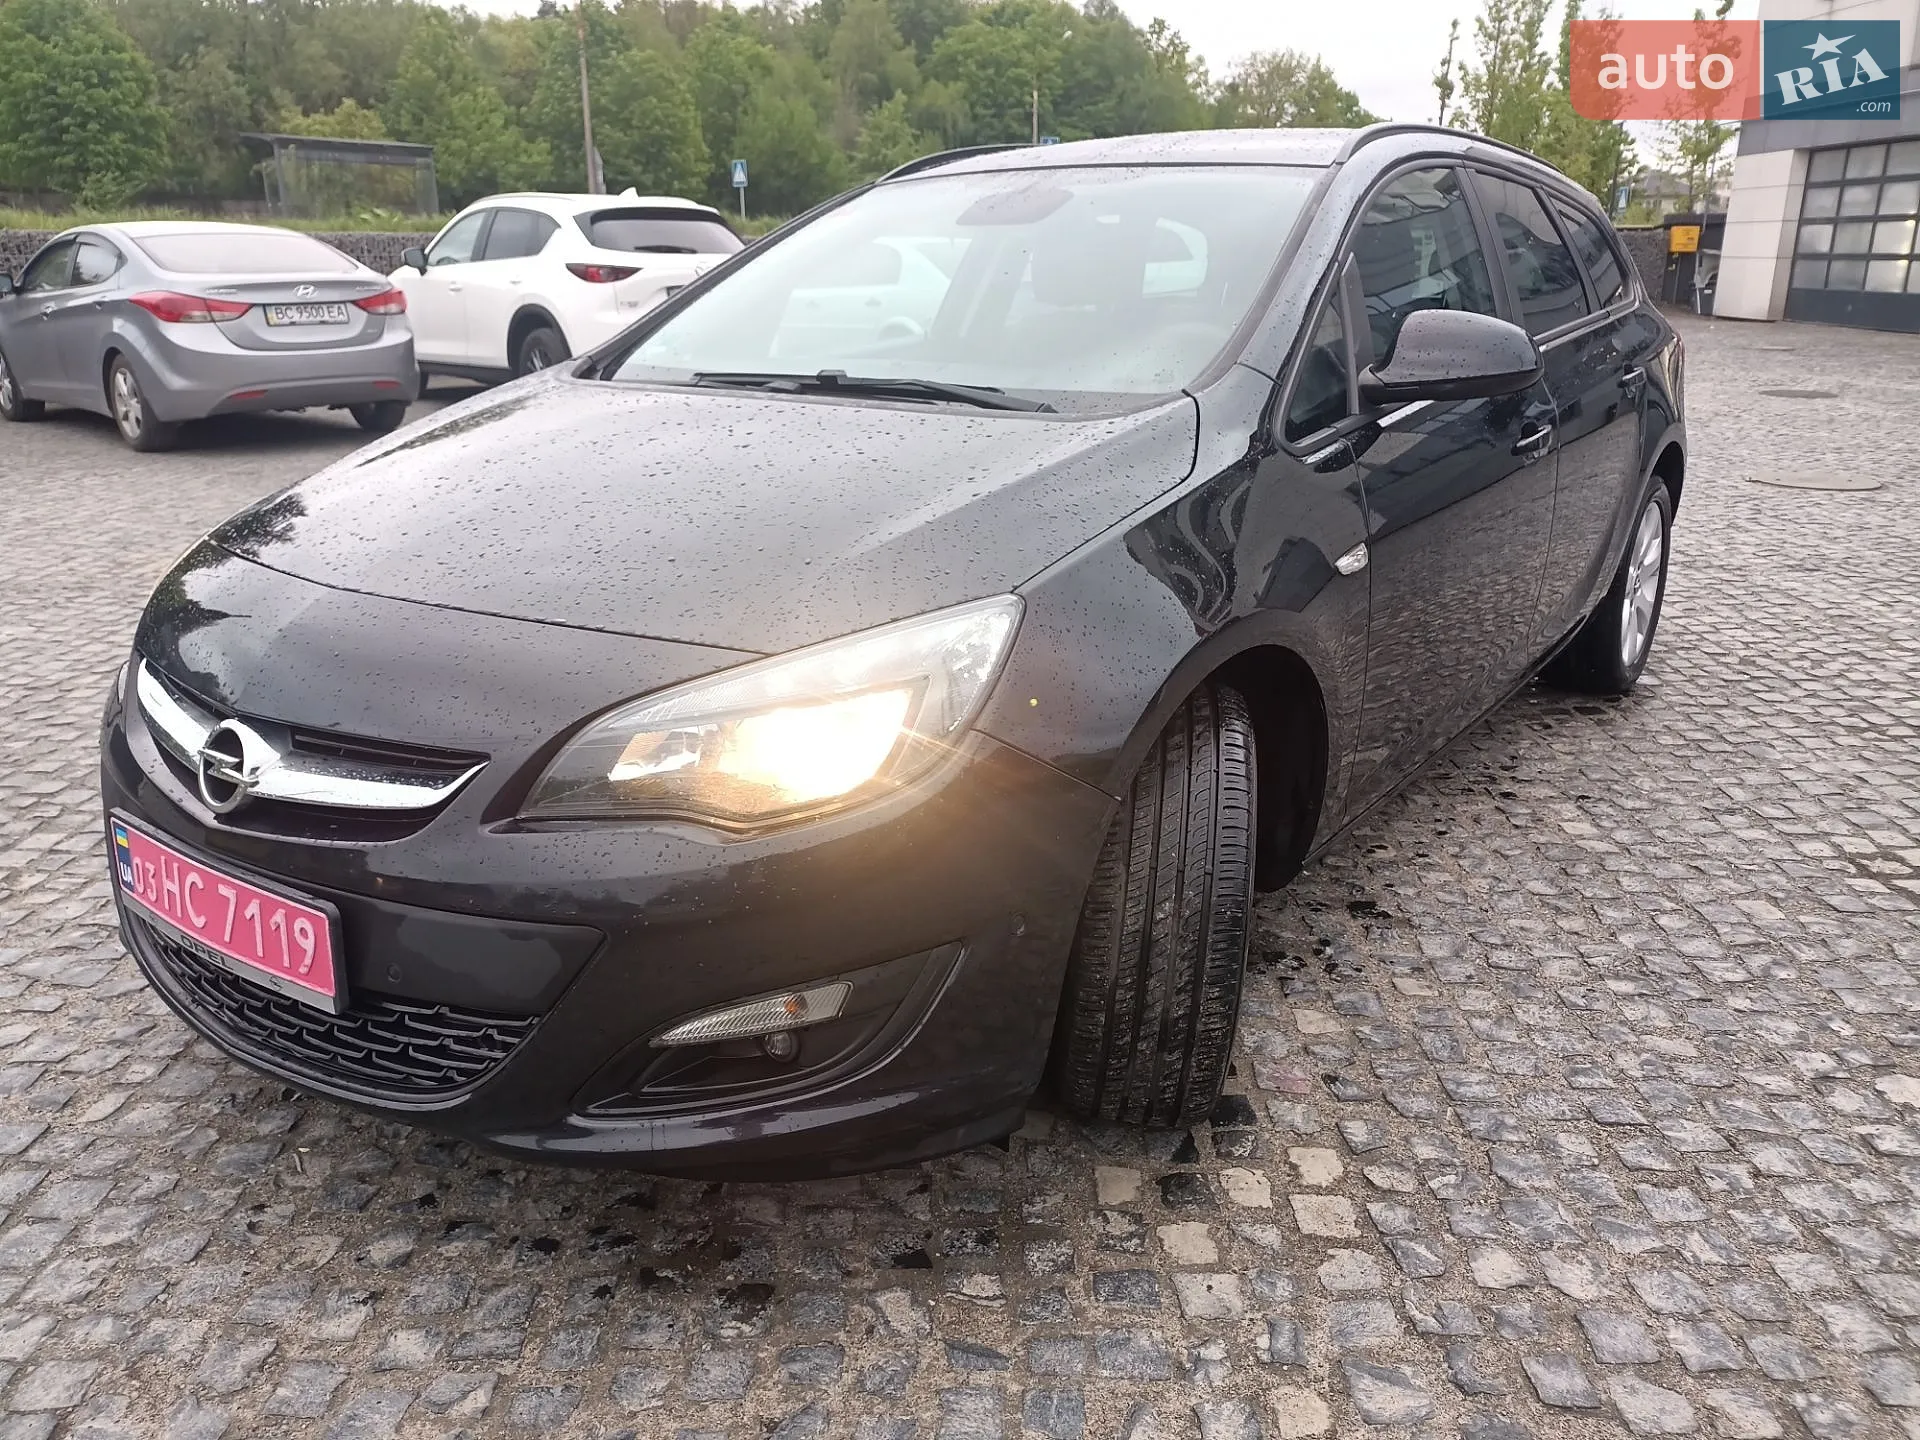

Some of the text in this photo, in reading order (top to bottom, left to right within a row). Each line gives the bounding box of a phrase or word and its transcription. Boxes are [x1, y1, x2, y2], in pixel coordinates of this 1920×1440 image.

[275, 304, 346, 321] BC 9500 EA
[120, 861, 134, 886] UA
[217, 883, 316, 976] 7119
[180, 934, 234, 971] OPEL
